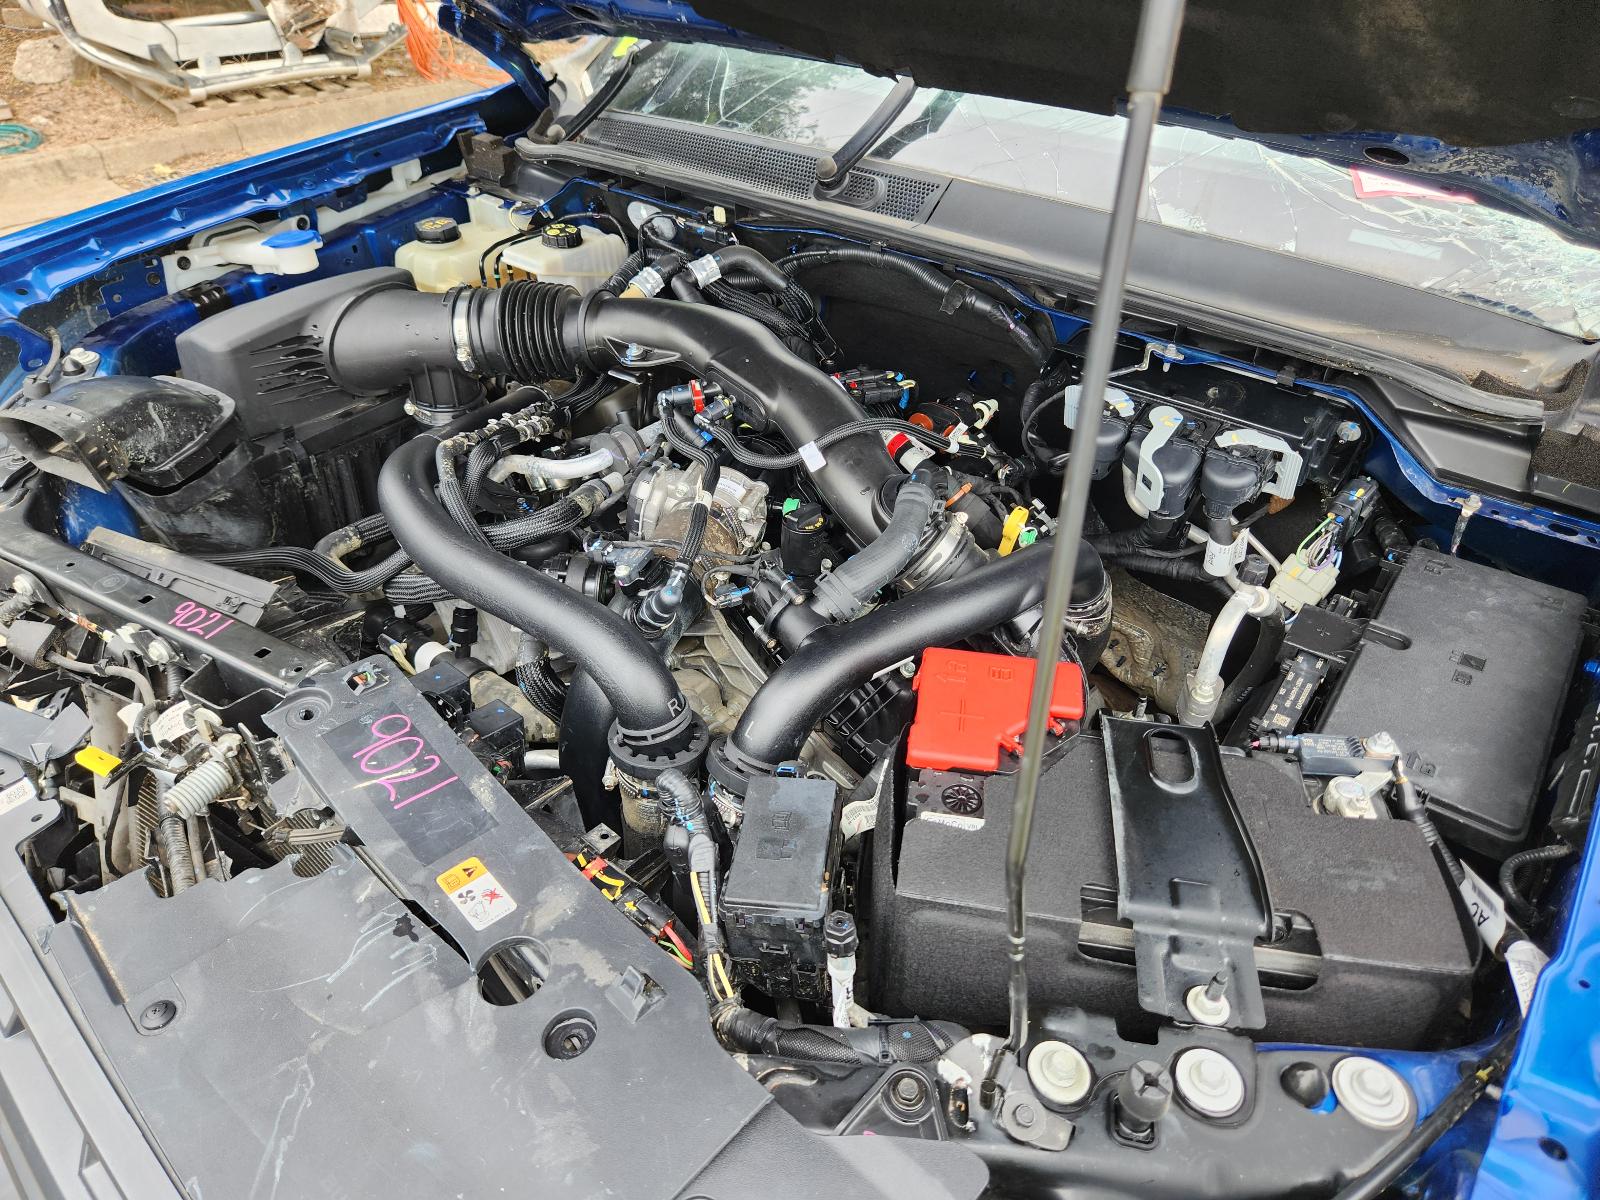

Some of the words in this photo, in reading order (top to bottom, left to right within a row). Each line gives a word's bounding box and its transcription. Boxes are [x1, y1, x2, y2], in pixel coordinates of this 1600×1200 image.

[168, 601, 234, 640] 9021
[667, 698, 682, 718] R
[352, 714, 459, 810] 9021
